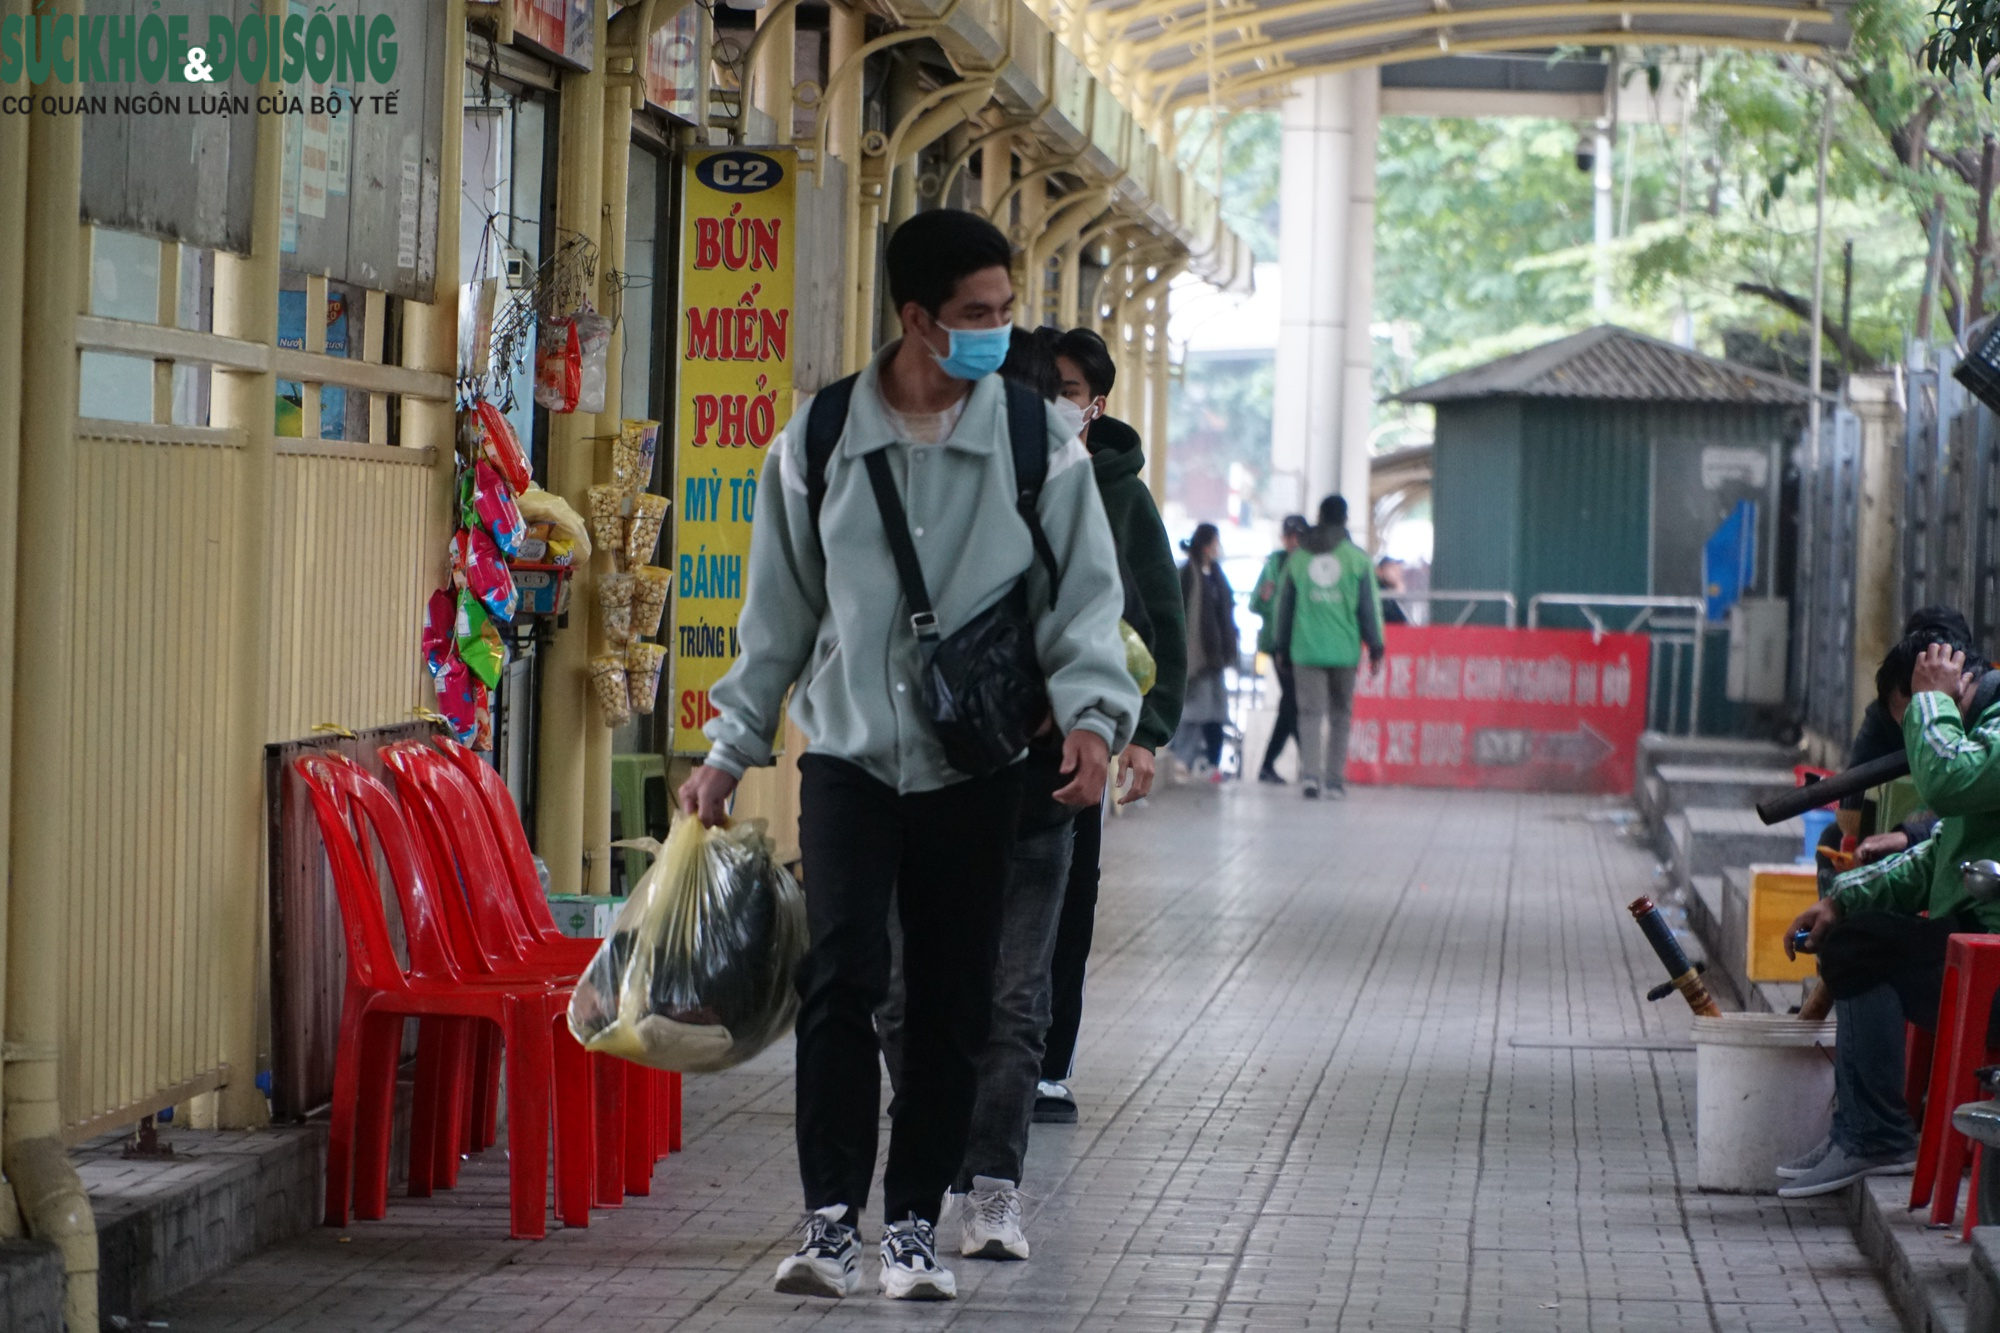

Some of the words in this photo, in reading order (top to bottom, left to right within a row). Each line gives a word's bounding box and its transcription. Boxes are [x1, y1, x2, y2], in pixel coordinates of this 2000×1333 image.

[712, 158, 769, 187] C2
[693, 201, 782, 272] BÚN
[685, 282, 790, 362] MIẾN
[692, 373, 778, 449] PHỞ
[684, 468, 723, 523] MỲ
[729, 470, 758, 523] TÔ
[679, 544, 741, 600] BÁNH
[679, 616, 725, 658] TRỨNG
[729, 614, 742, 658] V
